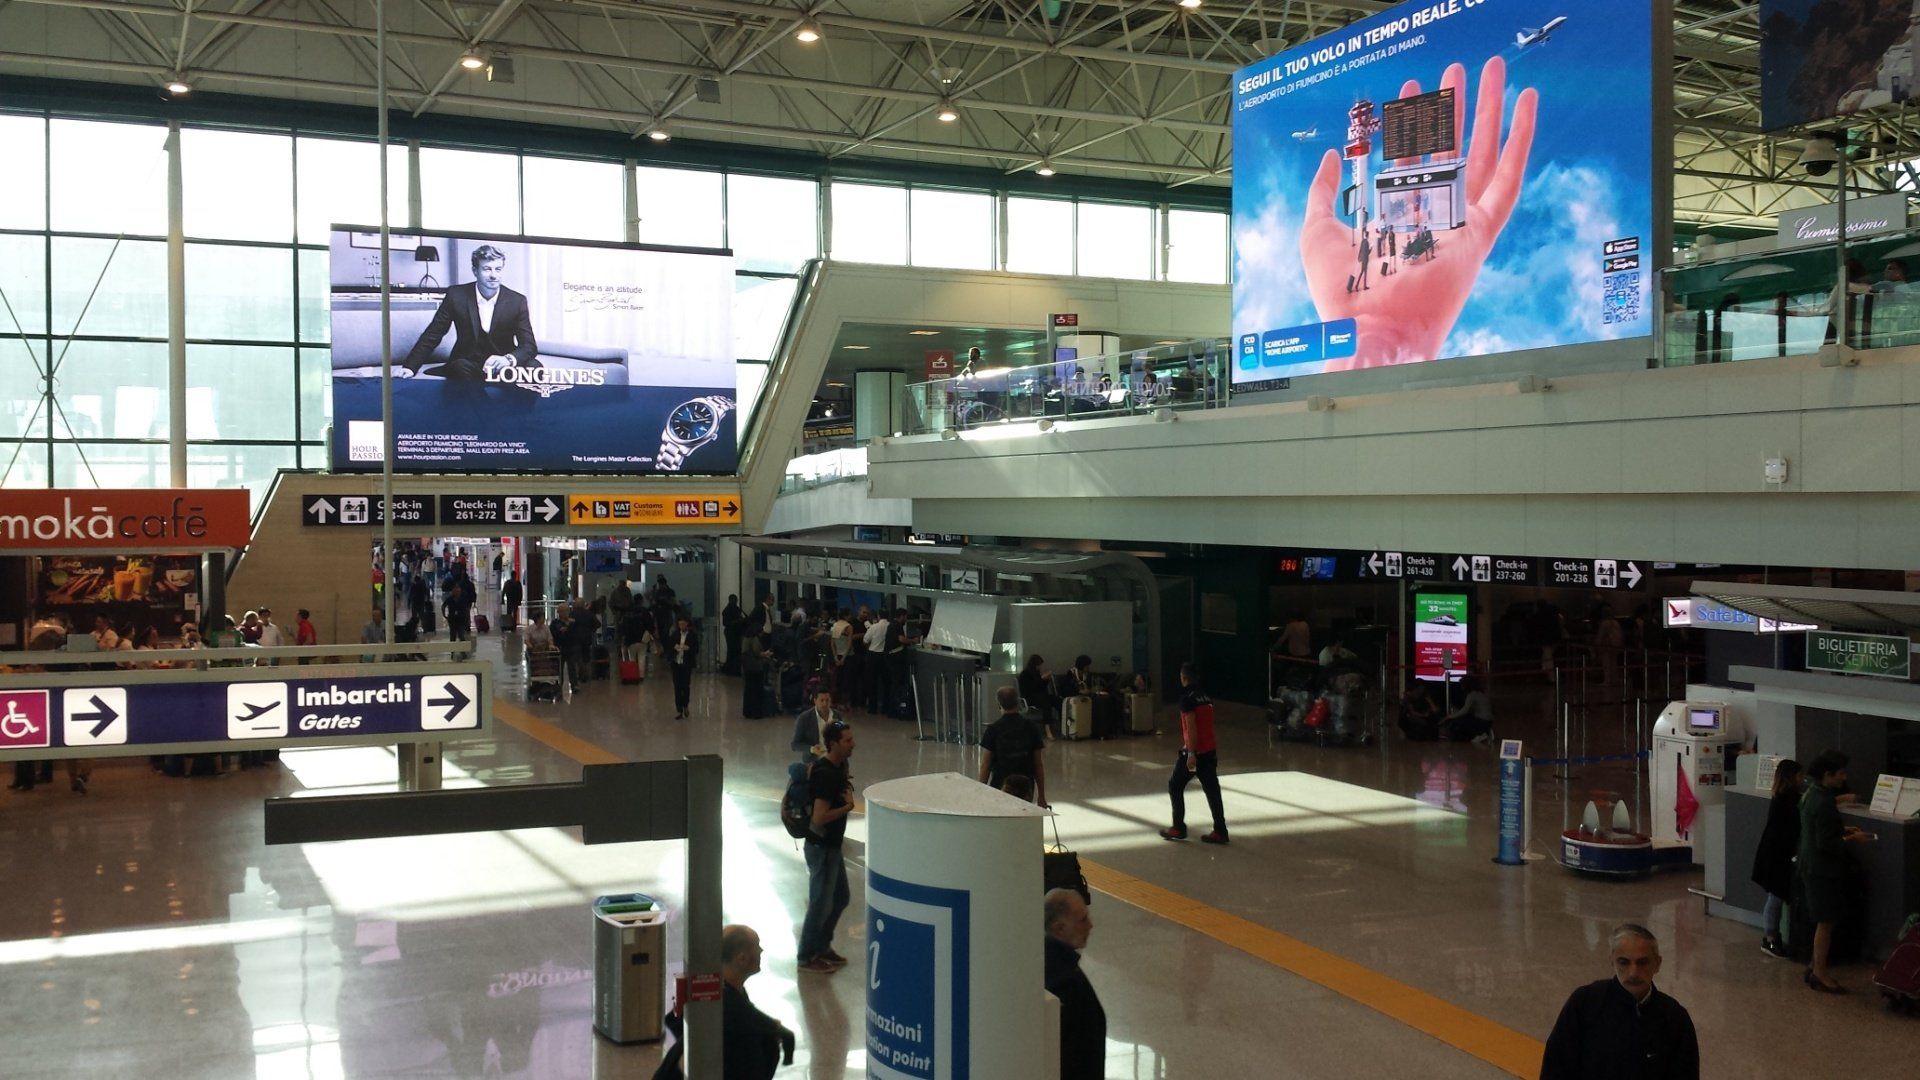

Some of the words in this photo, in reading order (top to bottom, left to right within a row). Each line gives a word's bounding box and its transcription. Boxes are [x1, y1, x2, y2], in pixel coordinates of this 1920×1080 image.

[1239, 71, 1270, 94] SEGUI
[1272, 67, 1283, 82] IL
[1285, 57, 1309, 76] TUO
[1311, 42, 1345, 66] VOLO
[1348, 34, 1361, 53] IN
[1364, 18, 1409, 46] TEMPO
[1412, 0, 1461, 29] REALE.
[1239, 87, 1286, 111] L'AEROPORTO
[1287, 83, 1295, 94] DI
[1296, 69, 1333, 90] FIUMICINO
[1334, 65, 1340, 76] È
[1341, 64, 1347, 74] A
[1349, 48, 1387, 70] PORTATA
[1388, 45, 1397, 57] DI
[1399, 34, 1426, 53] MANO.
[563, 282, 595, 292] Elegance
[616, 286, 643, 294] attitude
[1243, 336, 1256, 345] FCO
[1264, 339, 1285, 349] SCARICA
[485, 366, 605, 385] LONGINES
[352, 445, 378, 453] HOUR
[351, 452, 383, 460] PASSIO
[583, 455, 607, 463] Longines
[377, 500, 422, 509] Ceck-in
[453, 500, 497, 509] Check-in
[614, 503, 631, 511] VAT
[377, 511, 420, 520] 23-430
[456, 511, 497, 520] 261-272
[1406, 556, 1435, 566] Check-in
[1496, 560, 1528, 570] Check-in
[1406, 567, 1434, 576] 261-430
[1553, 561, 1588, 572] Check-in
[1495, 571, 1526, 581] 237-260
[1555, 573, 1588, 583] 201-236
[1428, 605, 1439, 613] 32
[1696, 603, 1730, 622] Safe
[1818, 637, 1898, 656] BIGLIETTERIA
[1826, 651, 1889, 669] TICKETING
[297, 683, 411, 706] Imbarchi
[299, 714, 362, 731] Gates
[892, 1049, 931, 1071] point
